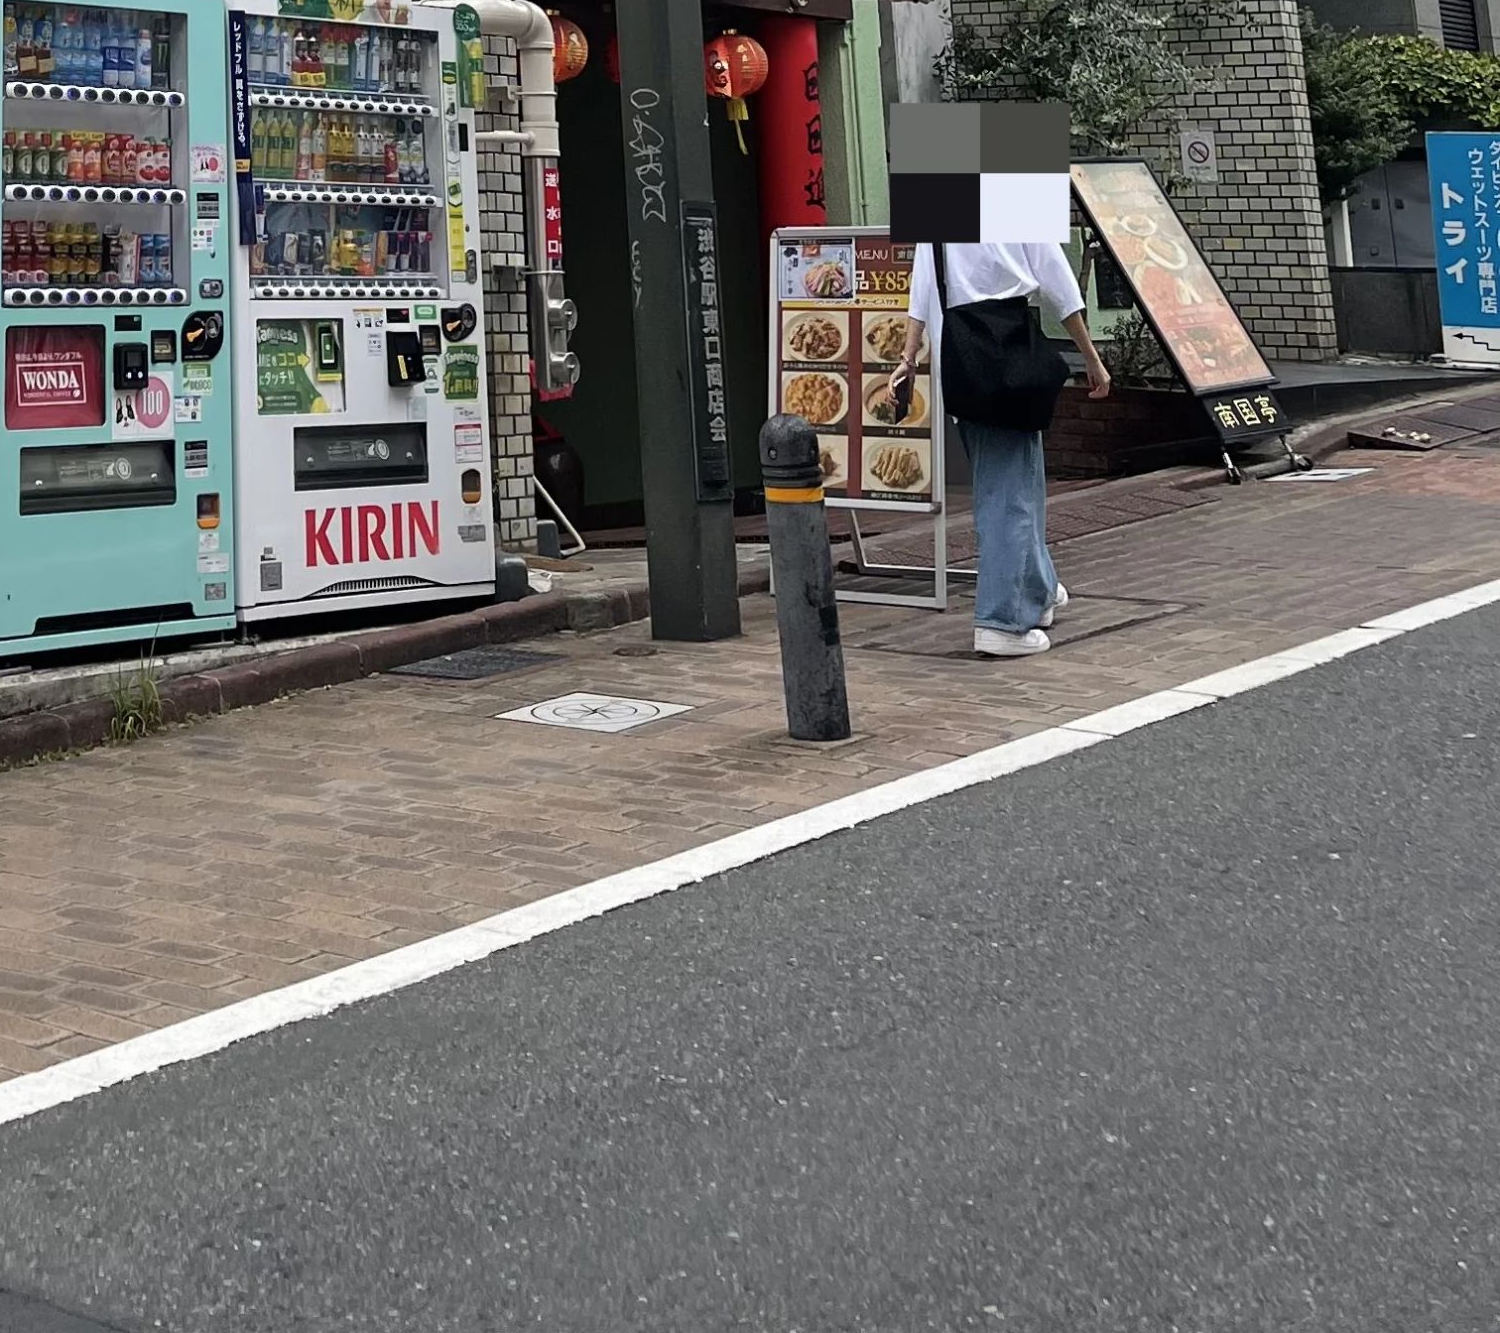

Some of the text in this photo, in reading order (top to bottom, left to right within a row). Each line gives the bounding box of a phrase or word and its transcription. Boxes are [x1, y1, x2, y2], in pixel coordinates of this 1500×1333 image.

[1442, 183, 1467, 283] トライ
[697, 228, 726, 442] 渋谷駅東口商店会
[22, 370, 79, 390] WONDA
[142, 389, 163, 415] 100
[1214, 395, 1277, 428] 南国亭
[305, 500, 440, 567] KIRIN
